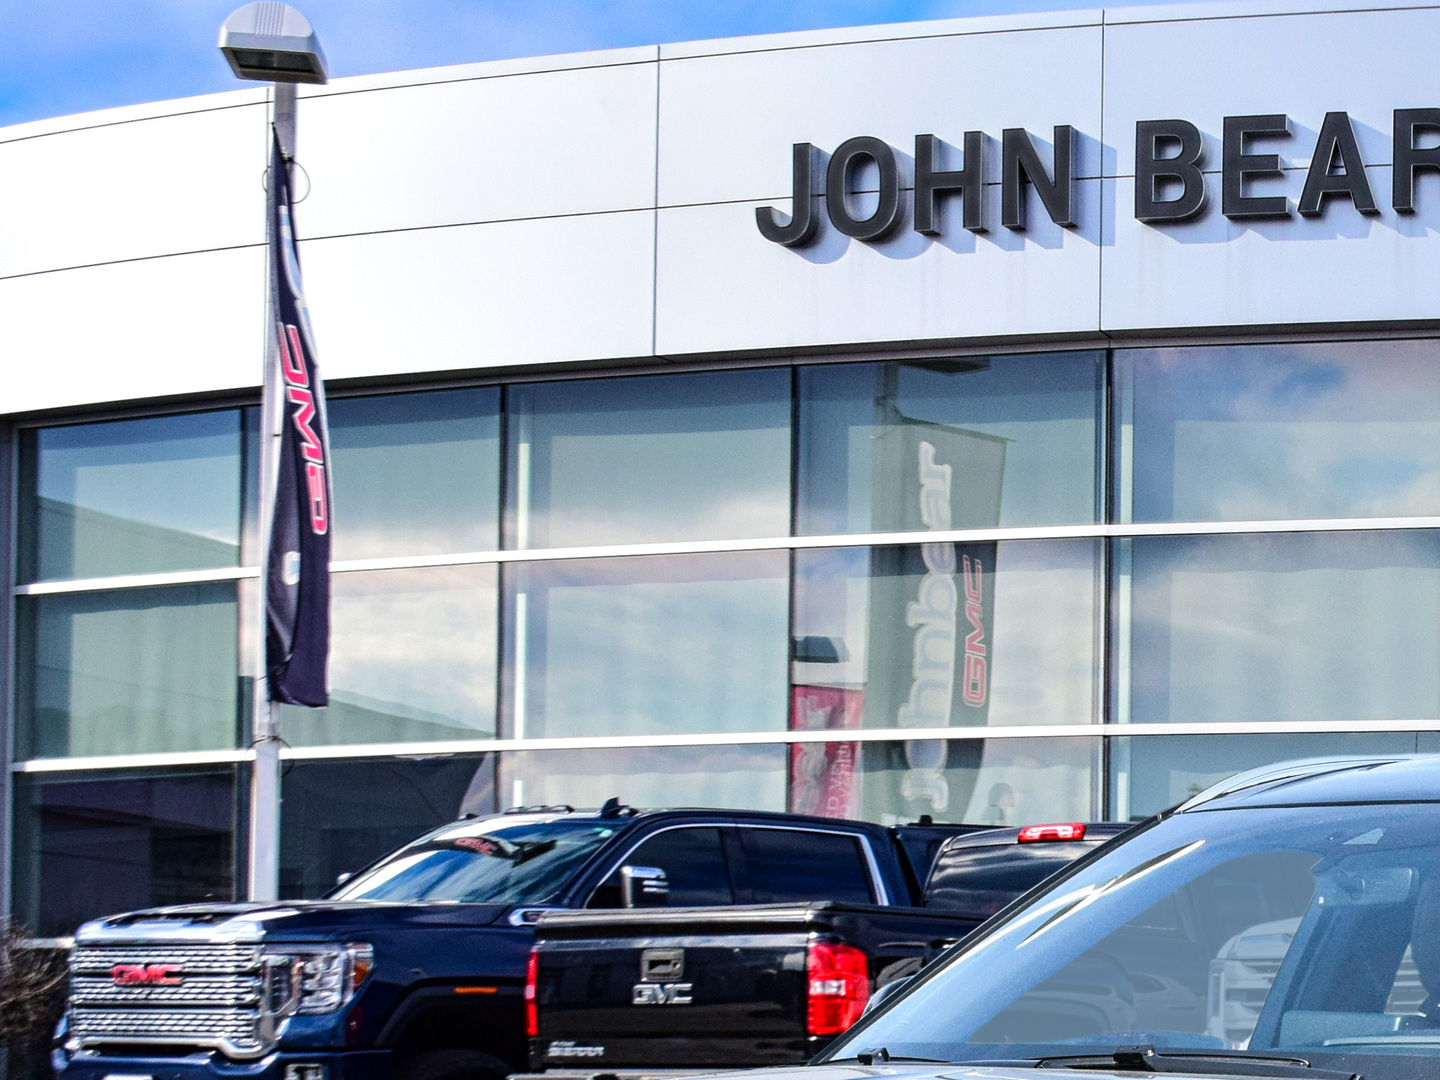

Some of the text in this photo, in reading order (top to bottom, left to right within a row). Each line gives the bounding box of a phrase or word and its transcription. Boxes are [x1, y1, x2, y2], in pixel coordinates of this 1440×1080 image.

[755, 124, 1078, 247] JOHN
[962, 554, 988, 708] GMC
[112, 964, 182, 984] GMC
[632, 983, 693, 1005] GMC
